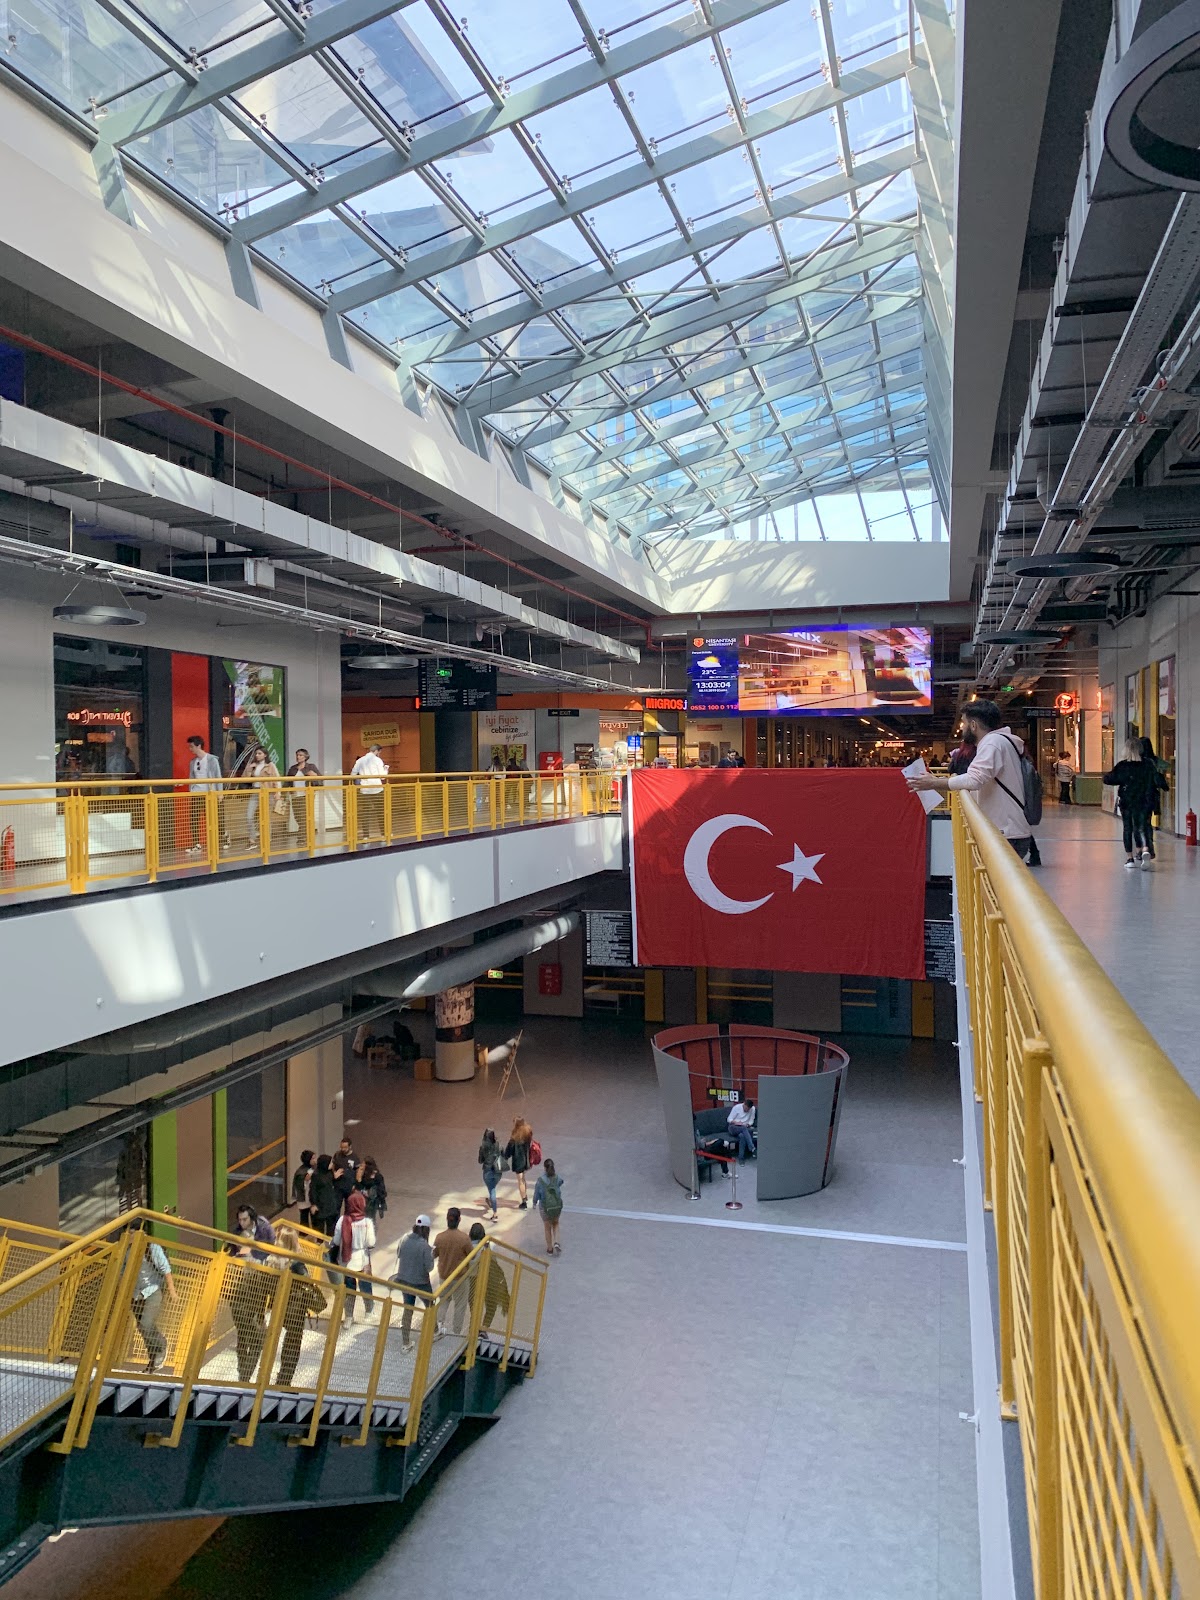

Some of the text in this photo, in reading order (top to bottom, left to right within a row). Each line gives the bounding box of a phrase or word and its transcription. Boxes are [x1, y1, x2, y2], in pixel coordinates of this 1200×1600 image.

[485, 714, 519, 726] iyi fiyat
[490, 725, 519, 733] cebinize
